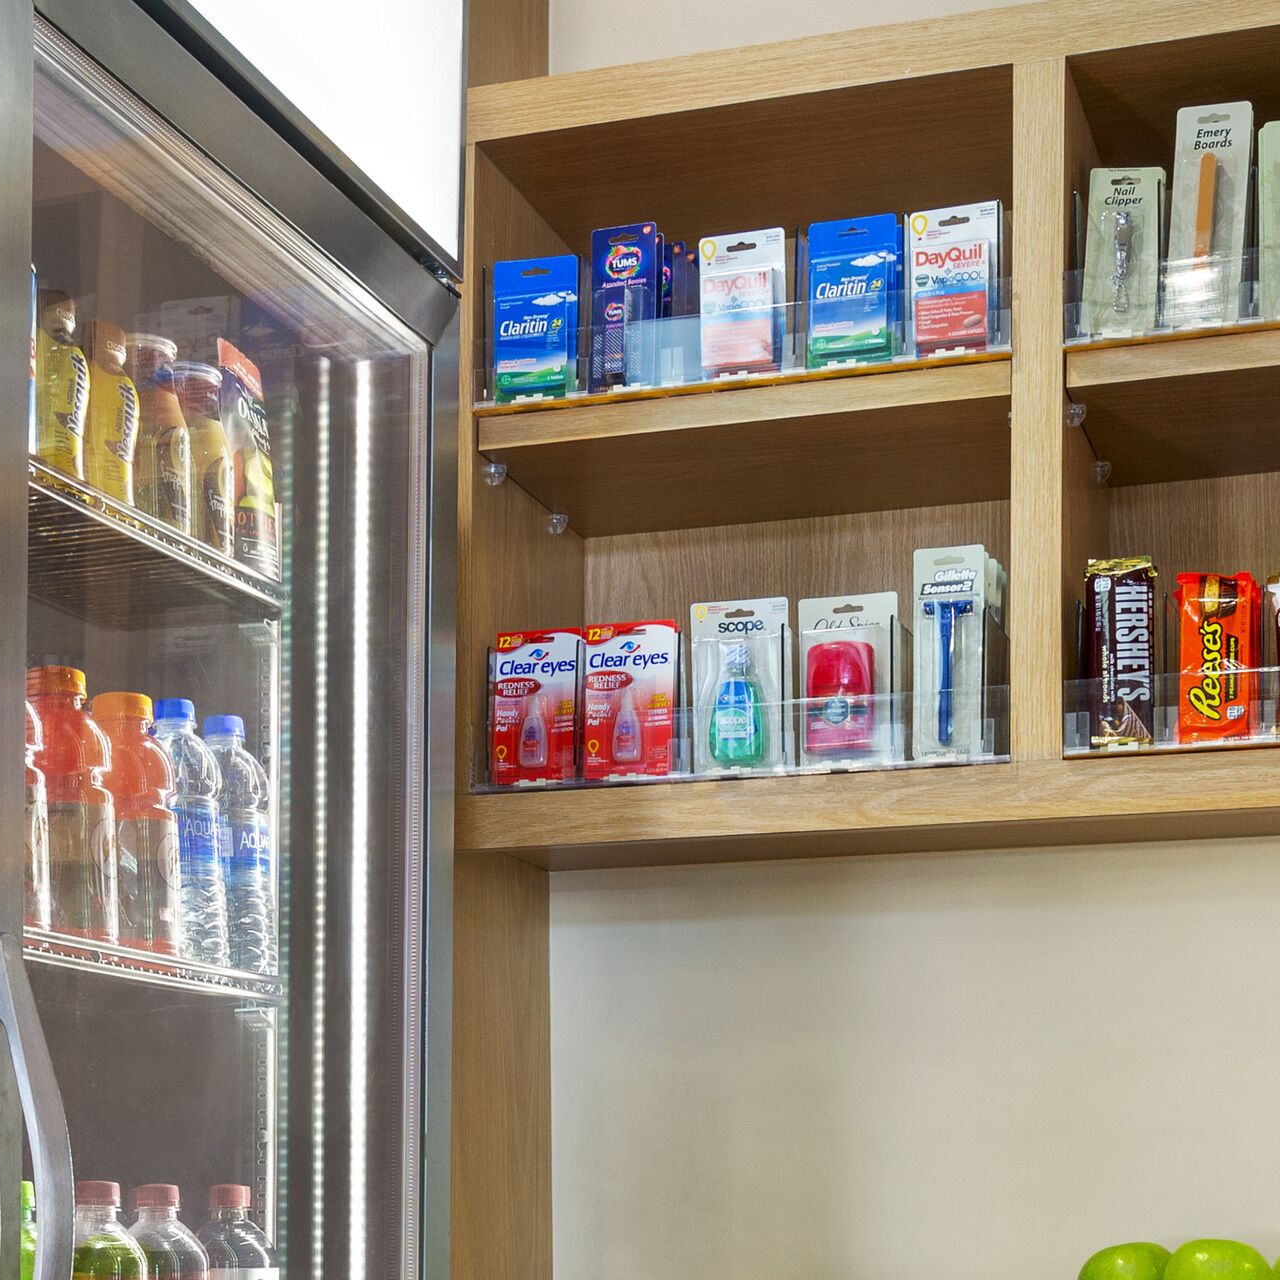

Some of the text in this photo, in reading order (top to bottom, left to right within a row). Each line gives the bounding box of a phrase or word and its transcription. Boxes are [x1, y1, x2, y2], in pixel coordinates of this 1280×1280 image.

[1196, 128, 1232, 141] Emery
[1193, 138, 1233, 151] Boards
[1113, 187, 1136, 196] Nail
[1104, 195, 1143, 207] Clipper
[915, 243, 982, 268] DayQuil
[816, 281, 867, 299] Claritin
[499, 317, 547, 337] Claritin
[934, 570, 977, 583] Gillette
[922, 581, 972, 594] Sensor2
[718, 618, 764, 635] scope
[1115, 585, 1149, 701] HERSHEY'S
[499, 658, 575, 677] Clear eyes
[589, 650, 669, 670] Clear eyes
[1189, 620, 1222, 721] Reese's
[588, 674, 626, 683] REDNESS
[594, 681, 620, 689] RELIEF
